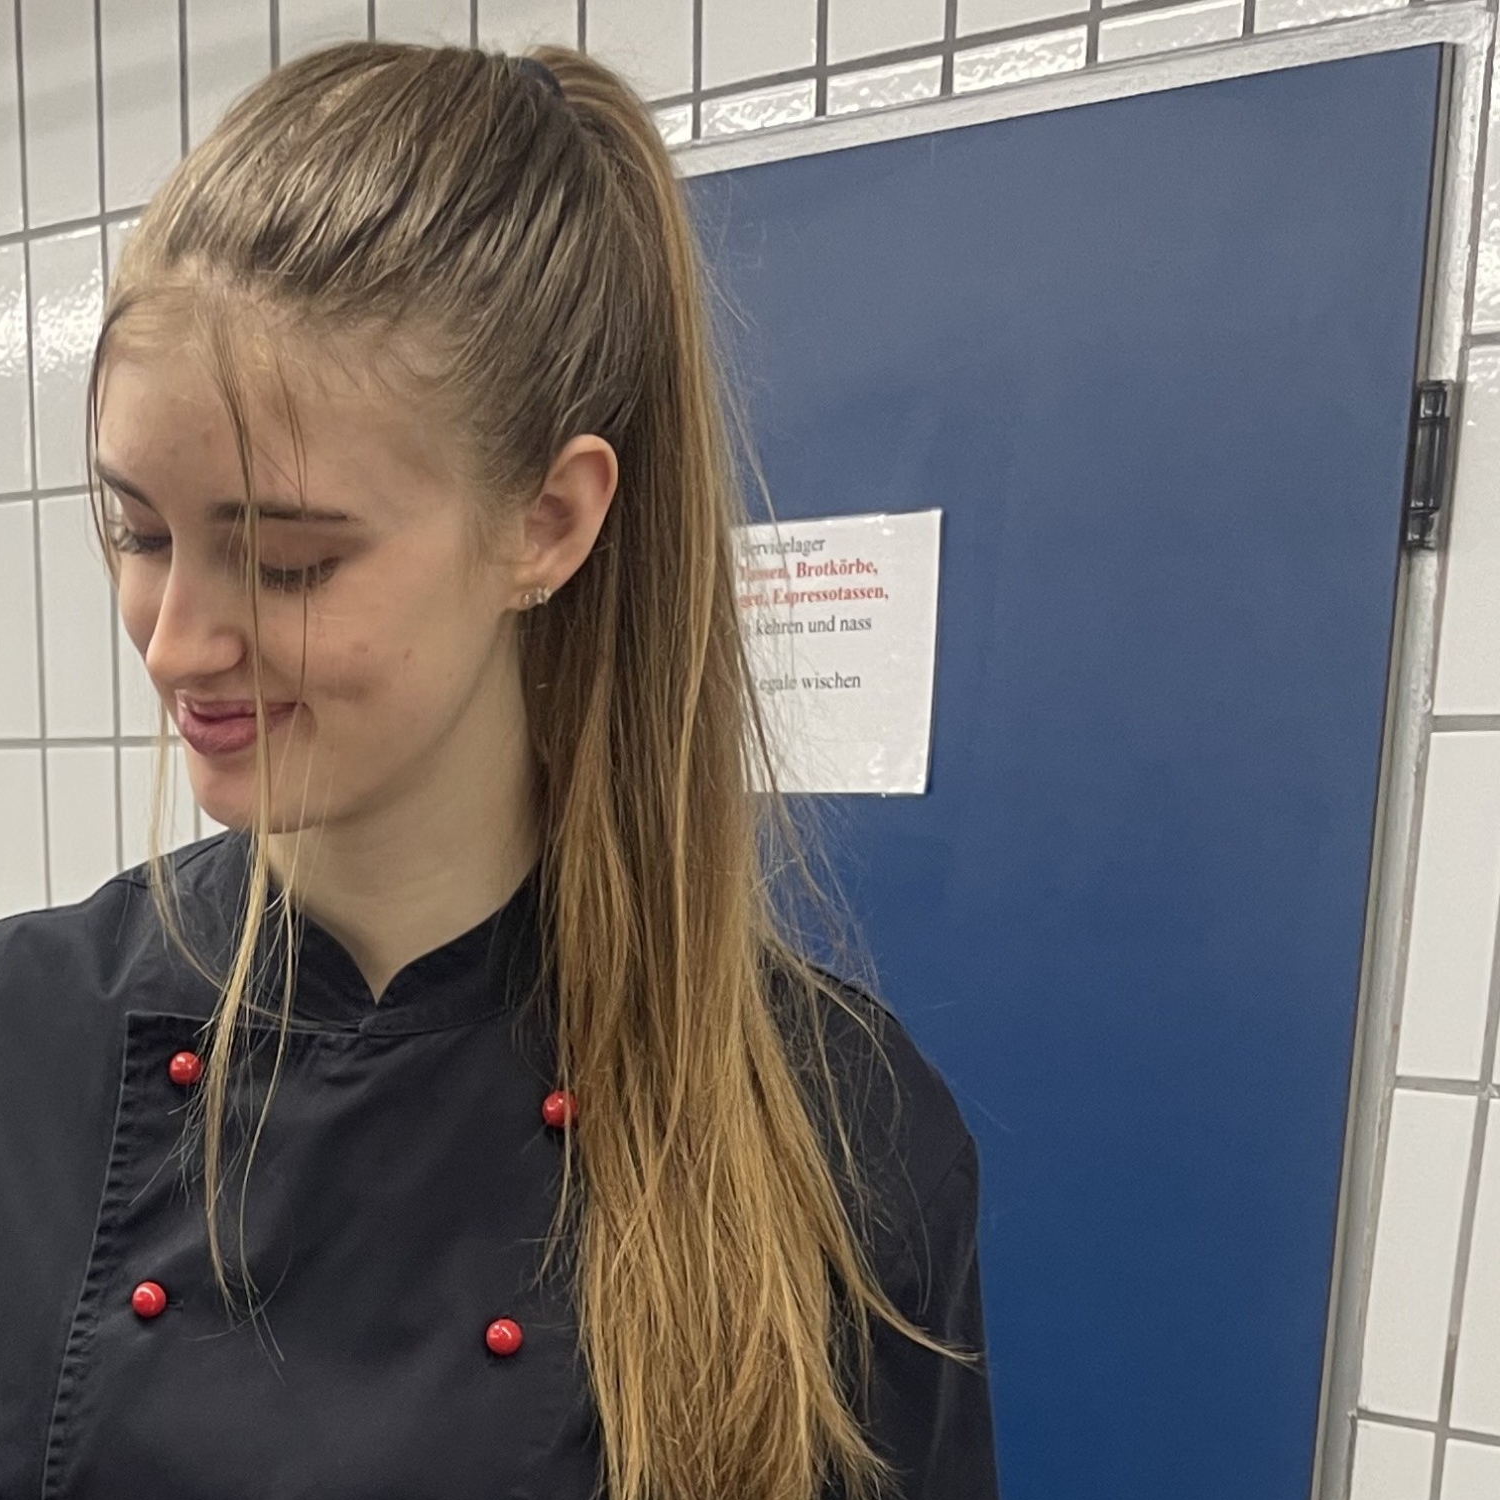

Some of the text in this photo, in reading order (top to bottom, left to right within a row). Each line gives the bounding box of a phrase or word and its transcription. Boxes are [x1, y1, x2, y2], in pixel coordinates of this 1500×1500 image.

[796, 557, 878, 579] Brotkörbe,
[773, 586, 889, 608] Espressotassen,
[756, 617, 804, 636] kehren
[808, 614, 836, 634] und
[839, 617, 872, 632] nass
[754, 671, 861, 696] egale wischen
